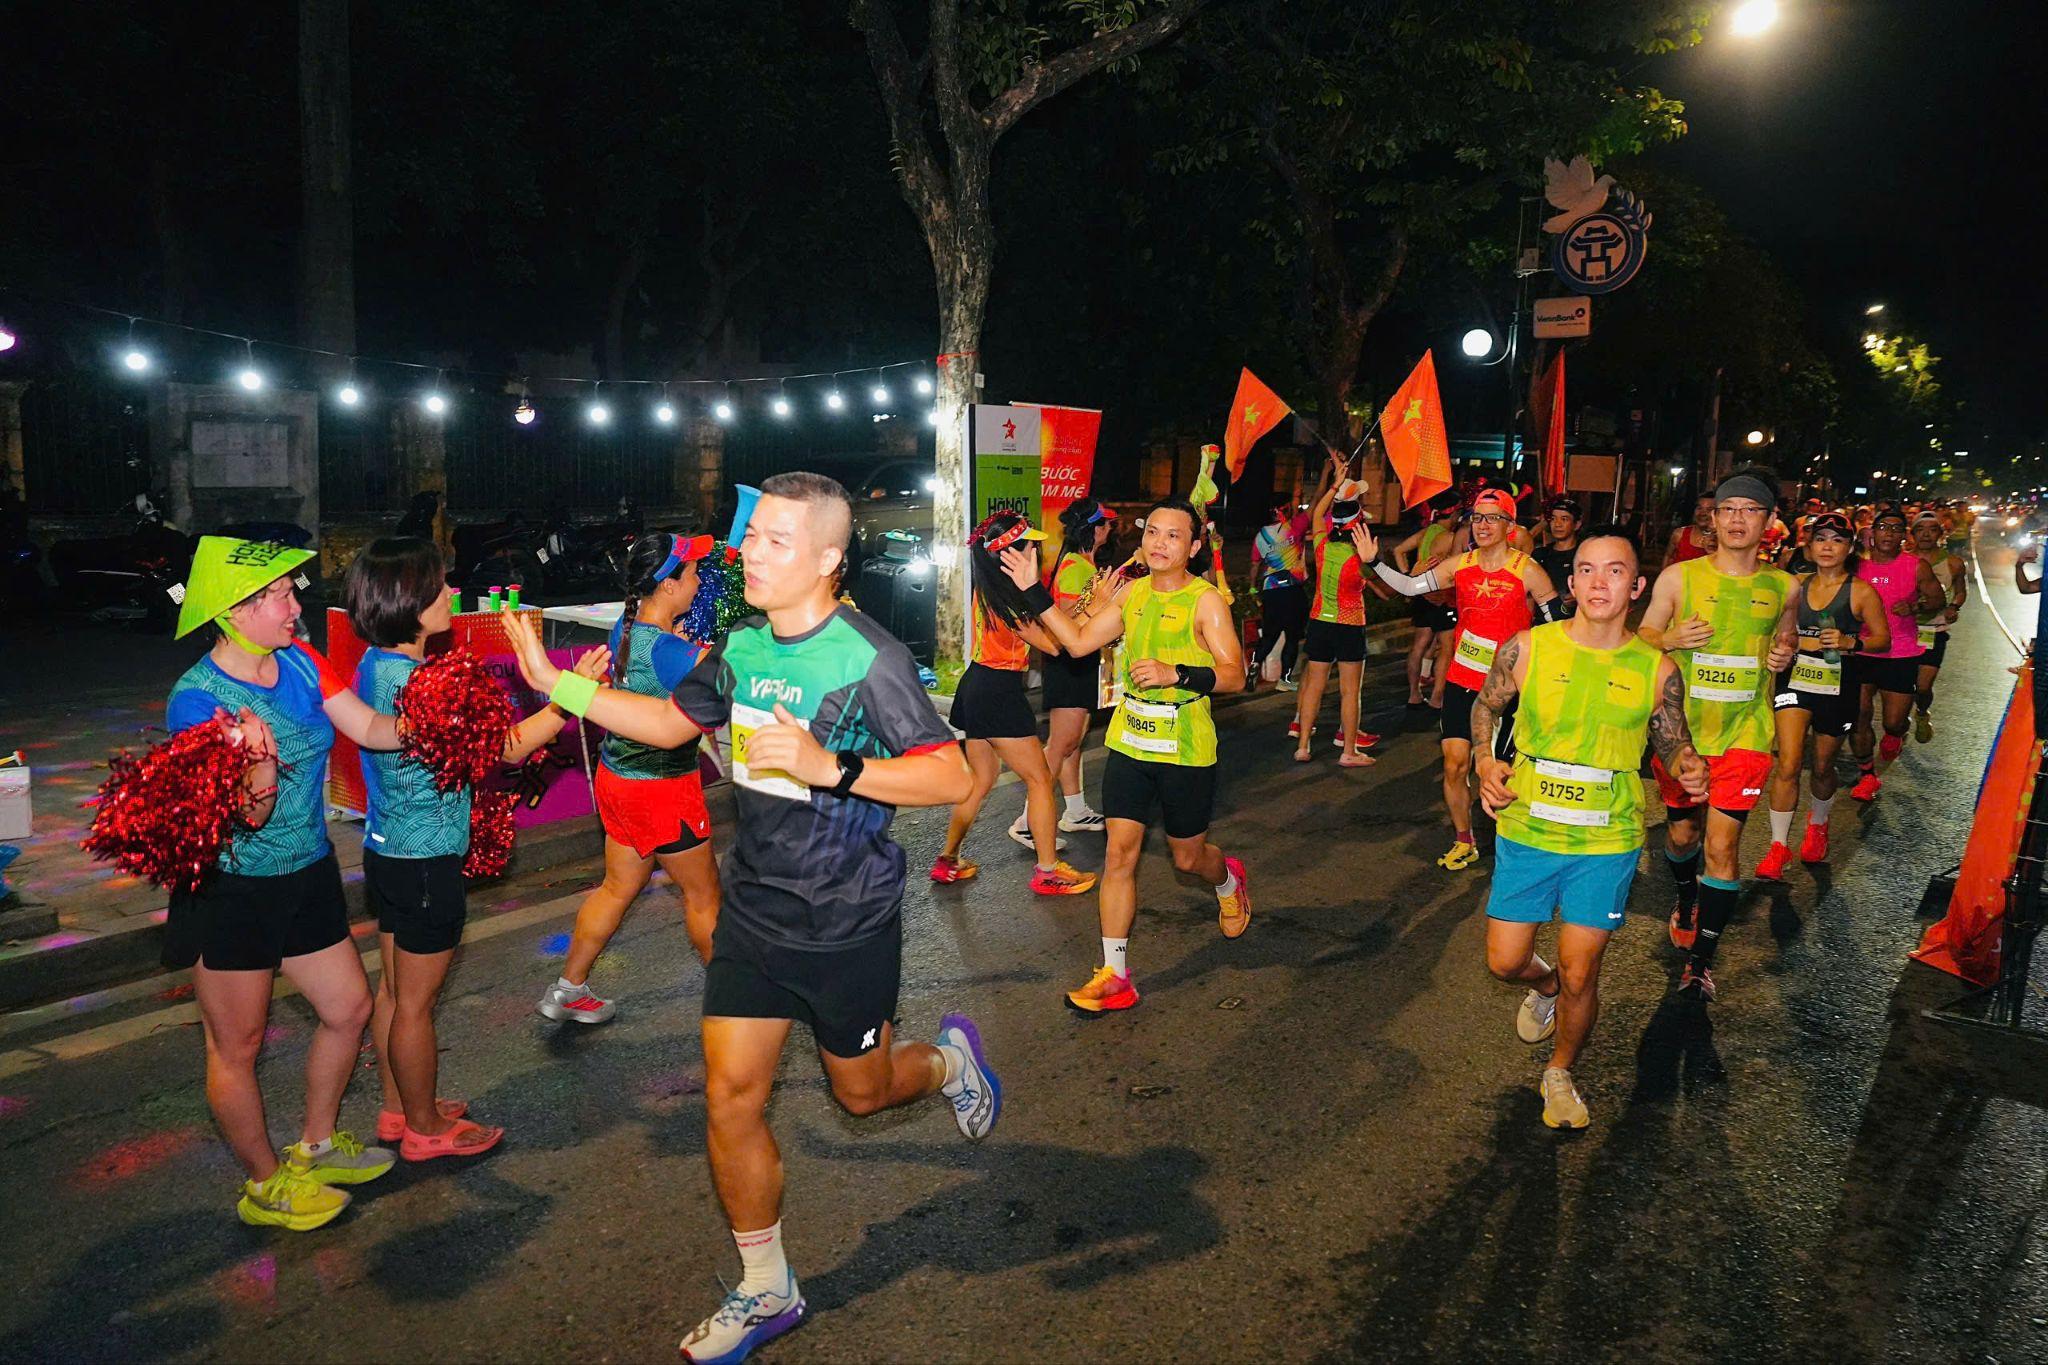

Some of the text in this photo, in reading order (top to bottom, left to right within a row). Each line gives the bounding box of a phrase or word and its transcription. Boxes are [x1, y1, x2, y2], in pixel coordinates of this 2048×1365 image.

[1697, 668, 1736, 684] 91216
[1126, 714, 1156, 733] 90845
[1540, 780, 1585, 802] 91752
